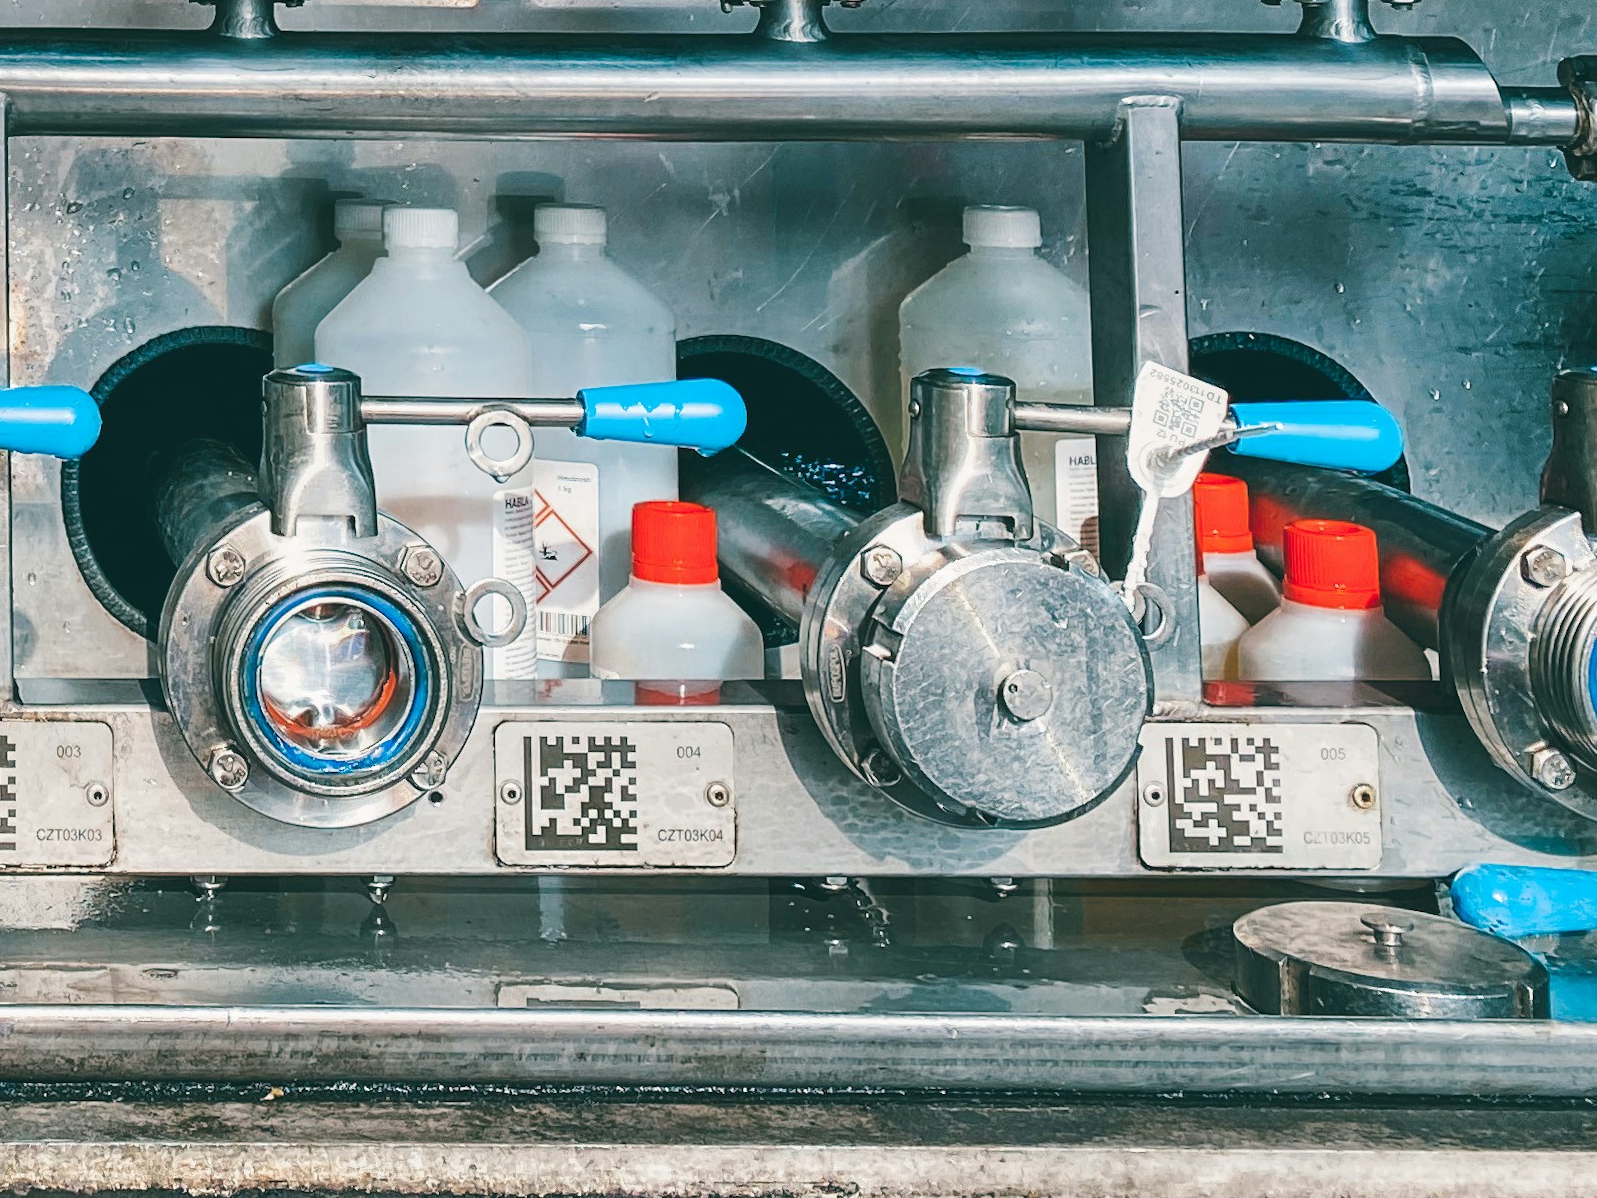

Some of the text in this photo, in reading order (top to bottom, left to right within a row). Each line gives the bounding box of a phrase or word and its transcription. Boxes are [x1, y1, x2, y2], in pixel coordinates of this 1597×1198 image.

[56, 745, 81, 758] 003
[676, 746, 701, 758] 004
[1320, 747, 1346, 760] 005
[36, 828, 103, 841] CZT03K03
[658, 829, 724, 842] CZT03K04
[1303, 831, 1371, 845] CZT03K05
